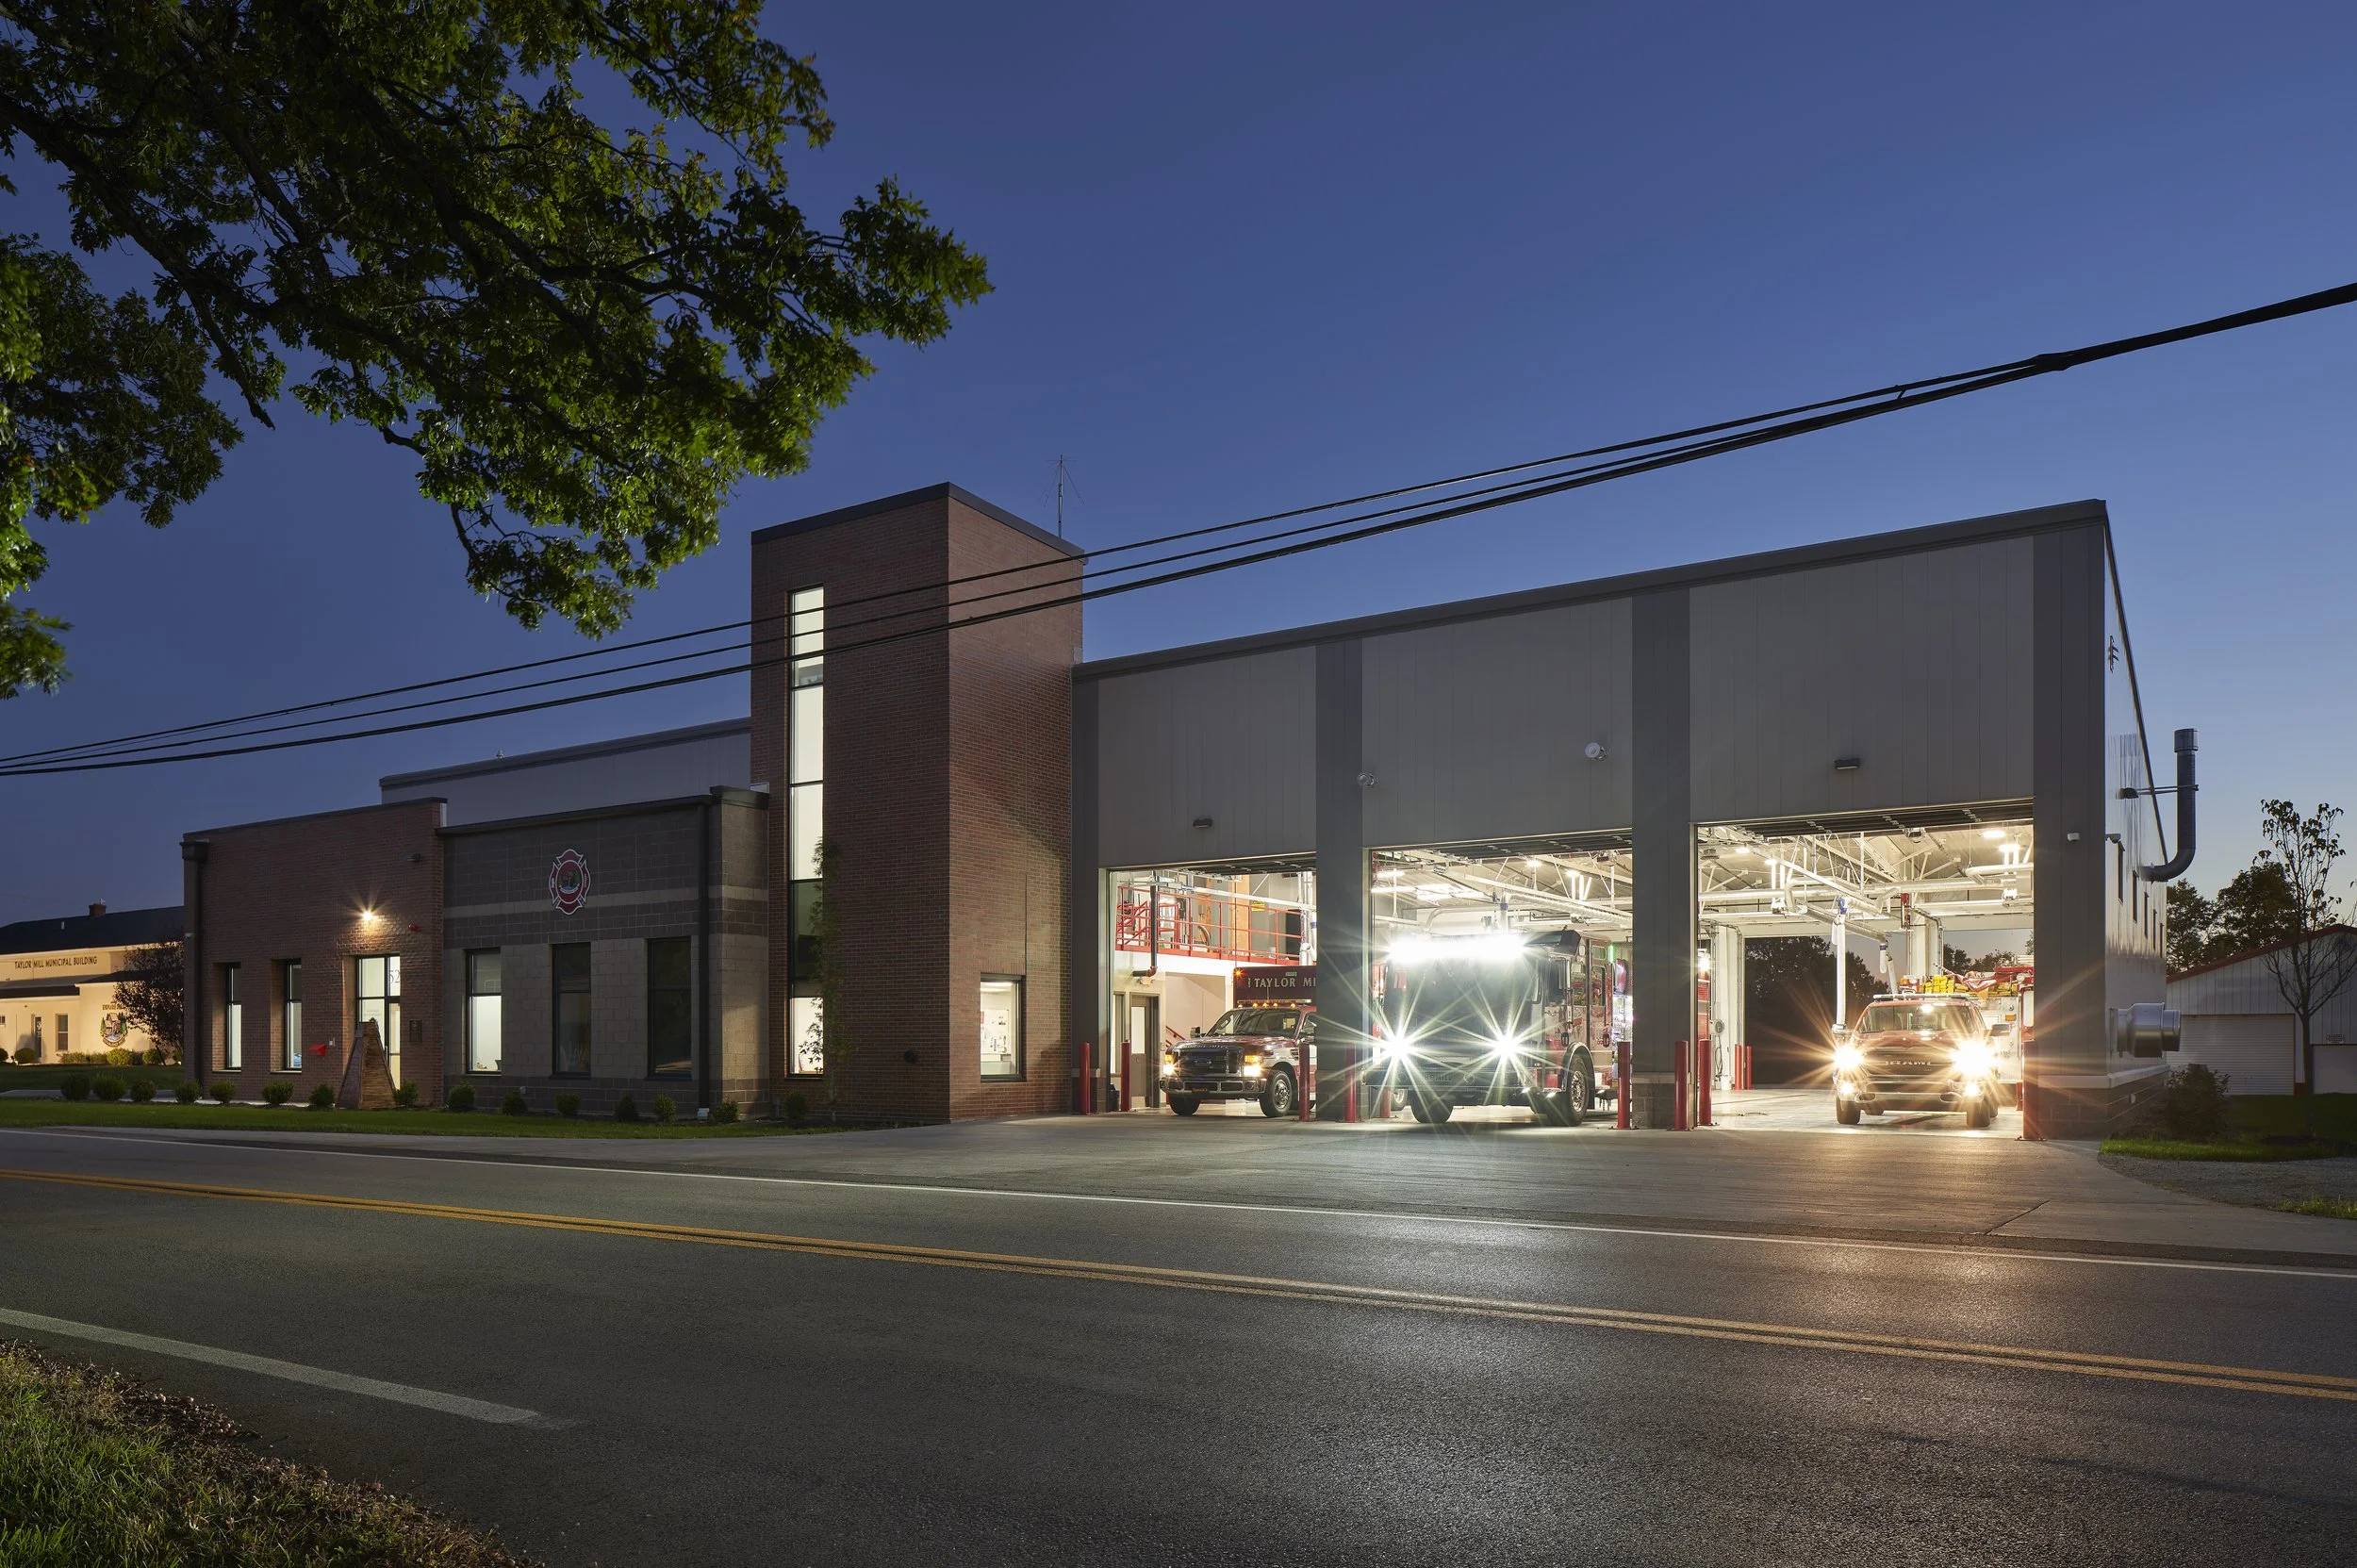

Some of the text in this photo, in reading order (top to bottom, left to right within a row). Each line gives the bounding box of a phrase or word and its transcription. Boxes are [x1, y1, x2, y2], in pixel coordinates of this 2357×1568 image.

[14, 956, 97, 969] TAYLOR MILL MUNICIPAL BUILDING
[1254, 978, 1295, 988] TAYLOR
